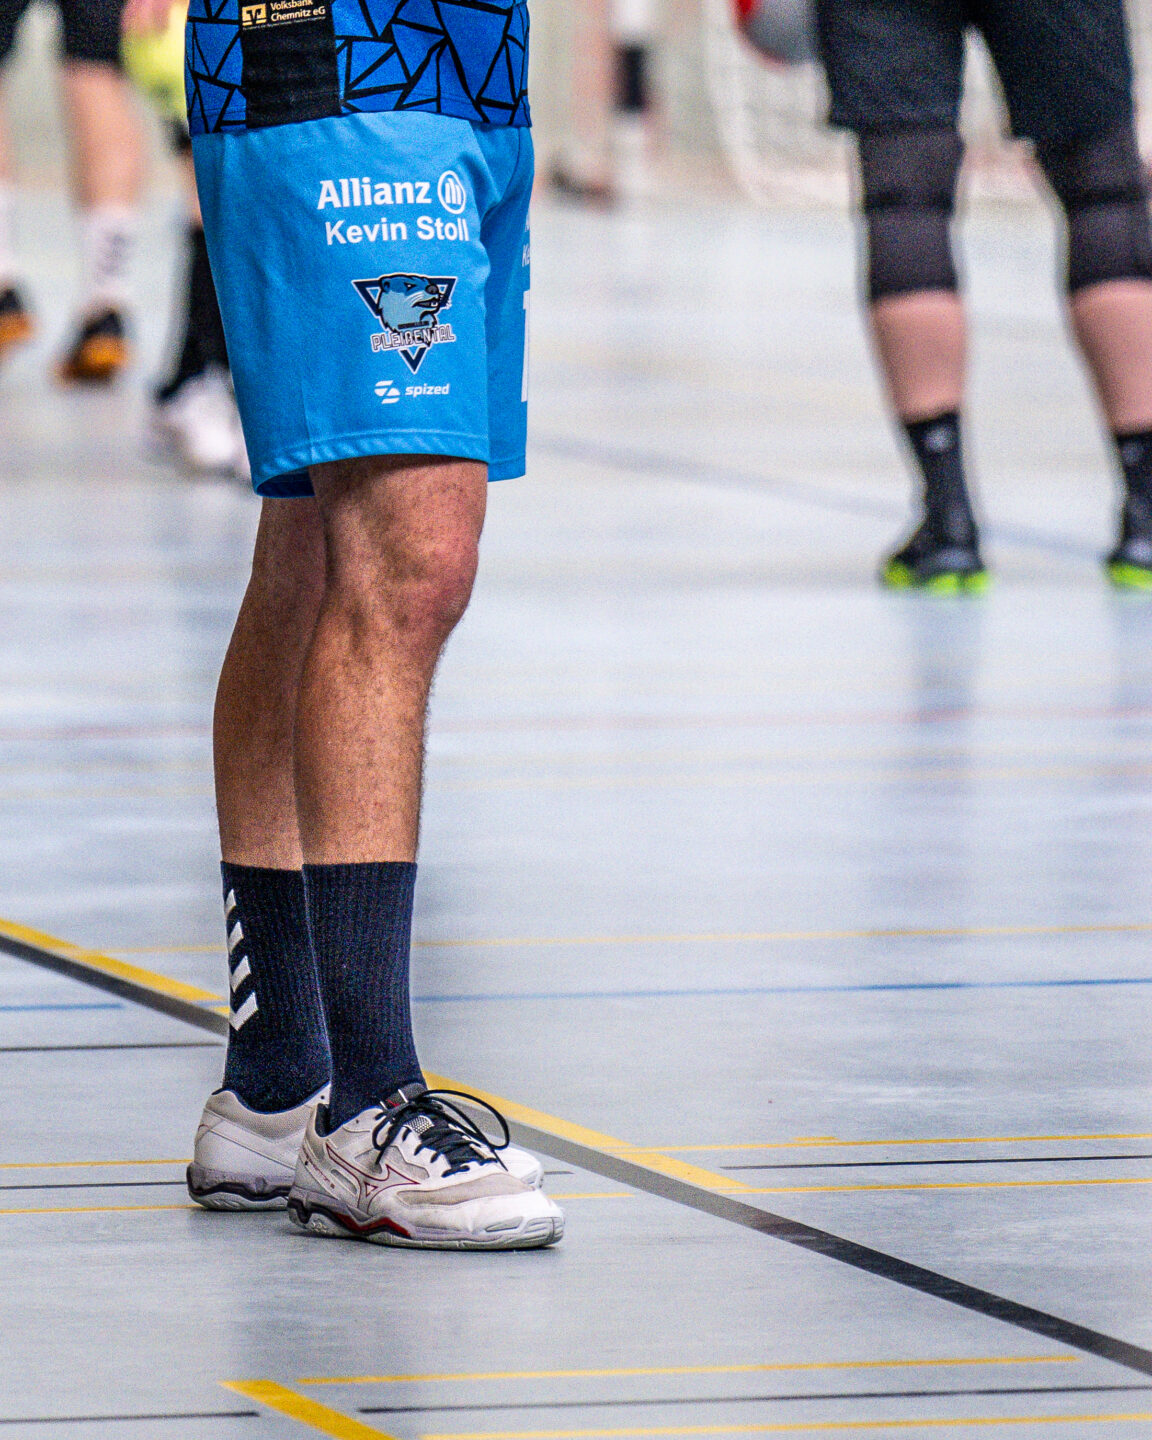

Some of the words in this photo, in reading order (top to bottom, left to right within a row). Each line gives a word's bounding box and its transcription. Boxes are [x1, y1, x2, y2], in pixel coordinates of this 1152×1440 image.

[270, 8, 312, 22] Chemnitz
[312, 6, 326, 17] eG
[317, 176, 433, 210] Allianz
[325, 217, 407, 246] Kevin
[416, 215, 470, 242] Stoll
[405, 382, 450, 397] spized
